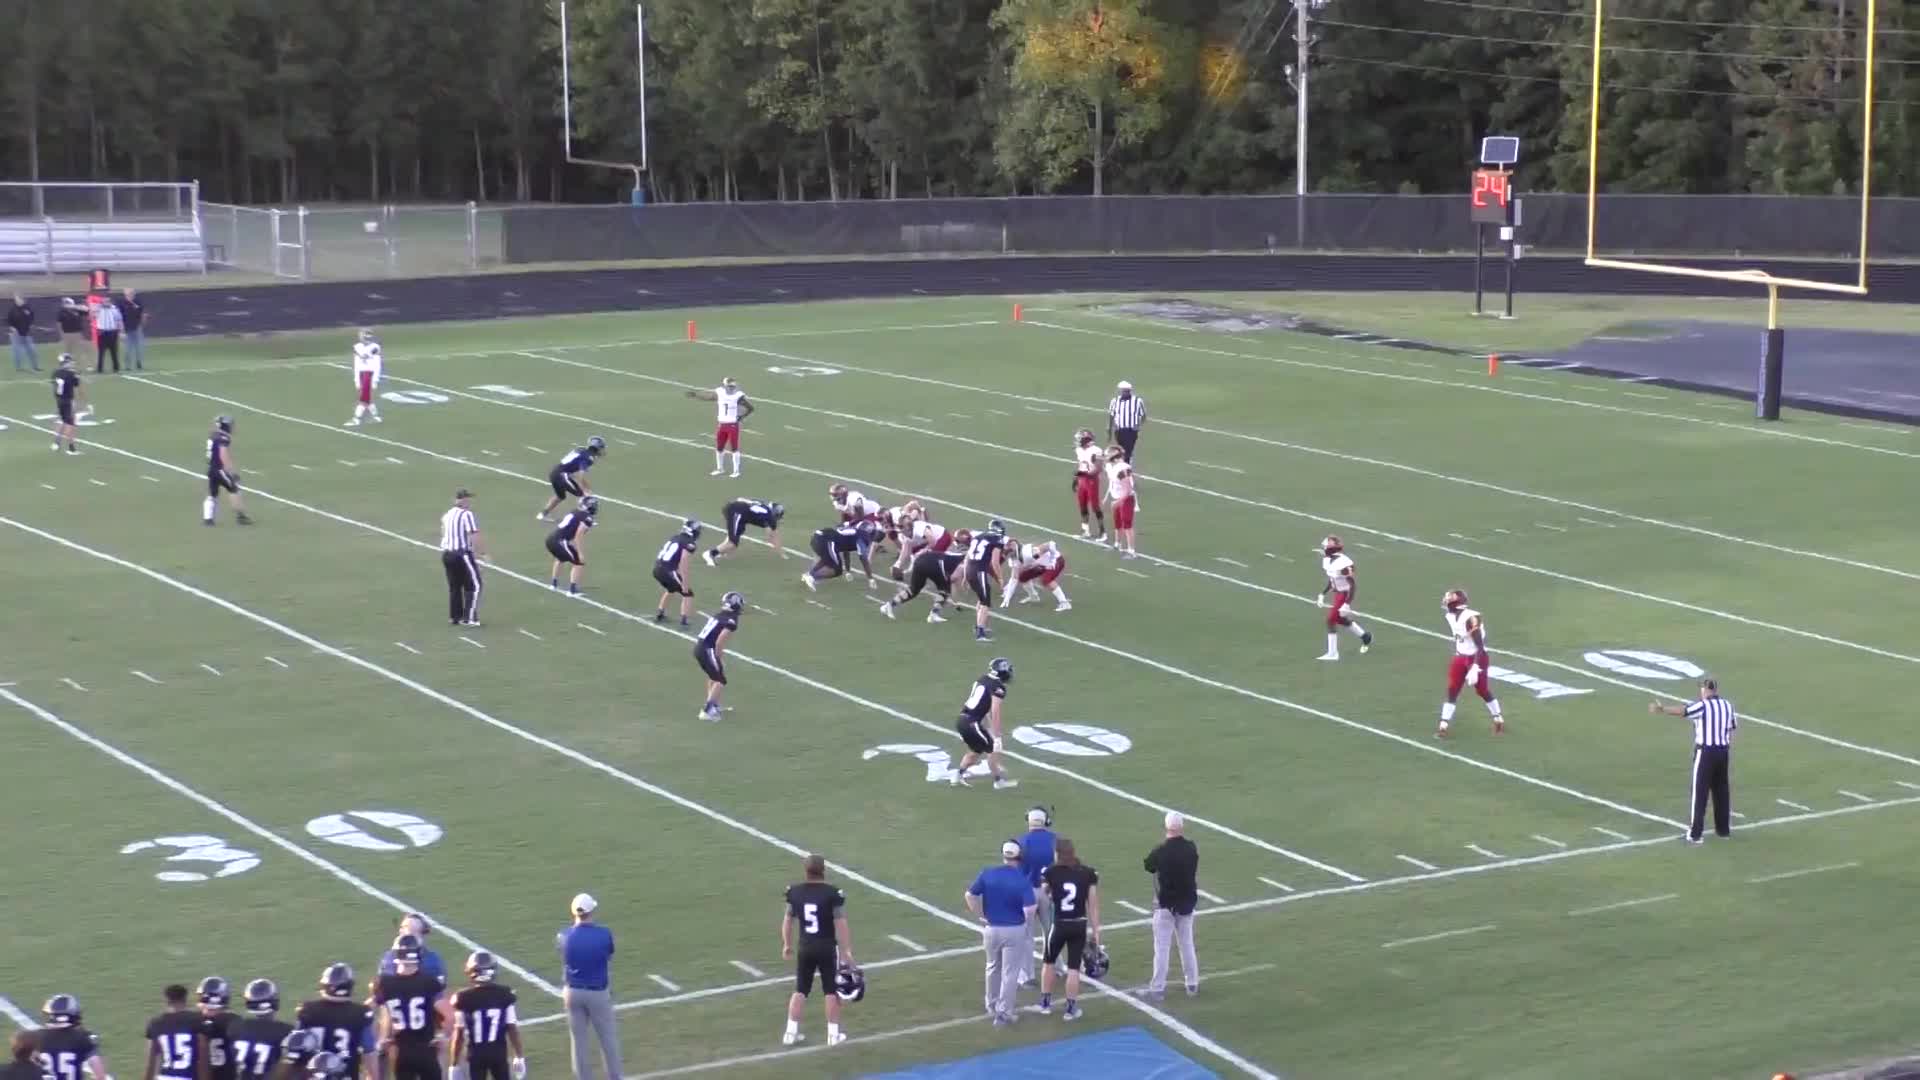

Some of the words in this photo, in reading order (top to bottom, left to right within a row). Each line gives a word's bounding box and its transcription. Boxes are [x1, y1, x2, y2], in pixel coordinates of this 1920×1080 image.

[1474, 173, 1505, 206] 24
[1061, 882, 1077, 911] 2
[804, 903, 819, 934] 5
[385, 996, 426, 1030] 56
[473, 1008, 501, 1043] 17
[157, 1033, 193, 1070] 15
[233, 1040, 271, 1075] 77
